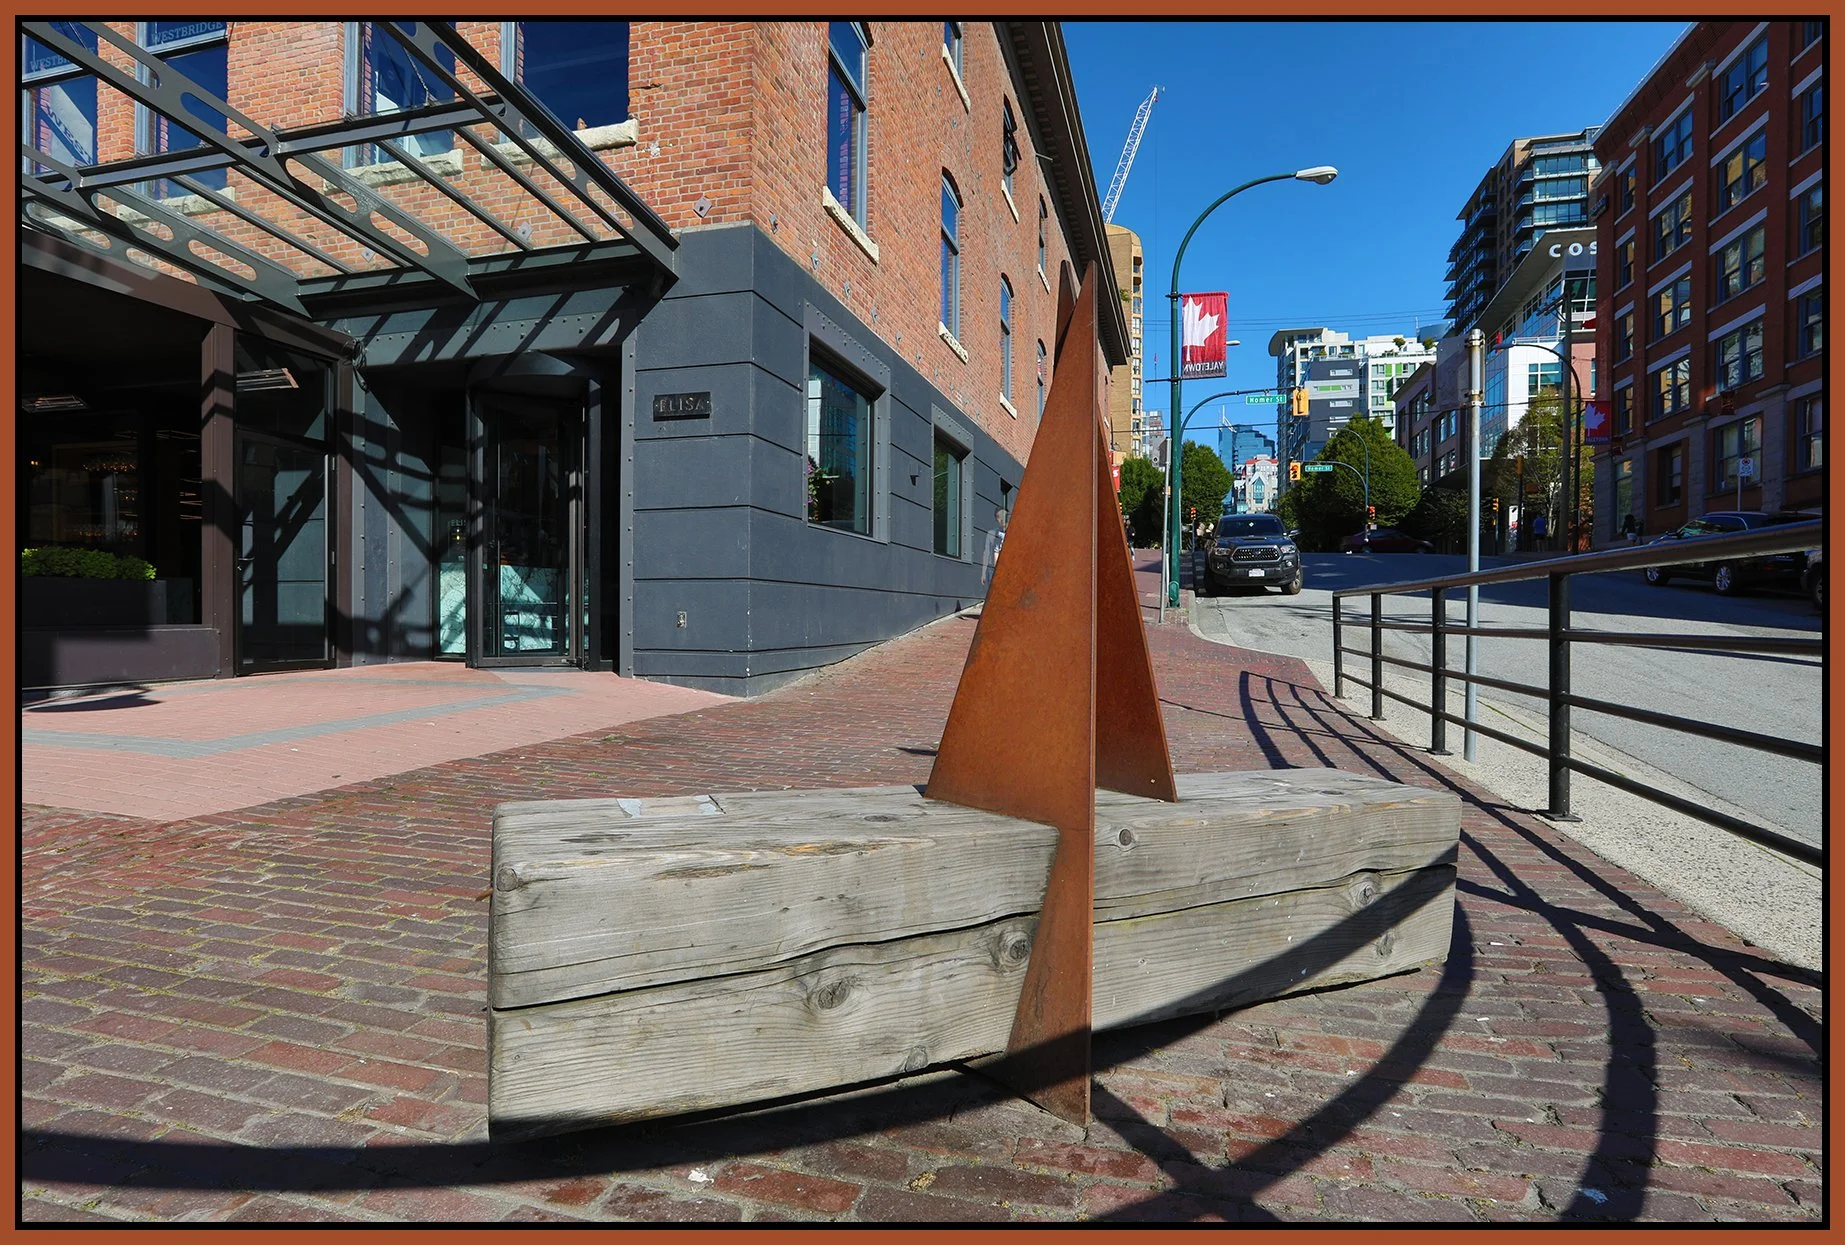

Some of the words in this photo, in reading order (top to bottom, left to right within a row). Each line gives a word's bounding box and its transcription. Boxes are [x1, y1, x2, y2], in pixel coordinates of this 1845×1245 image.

[151, 22, 224, 43] WESTBRIDGE
[659, 396, 704, 413] ELISA
[1249, 396, 1274, 404] Homer
